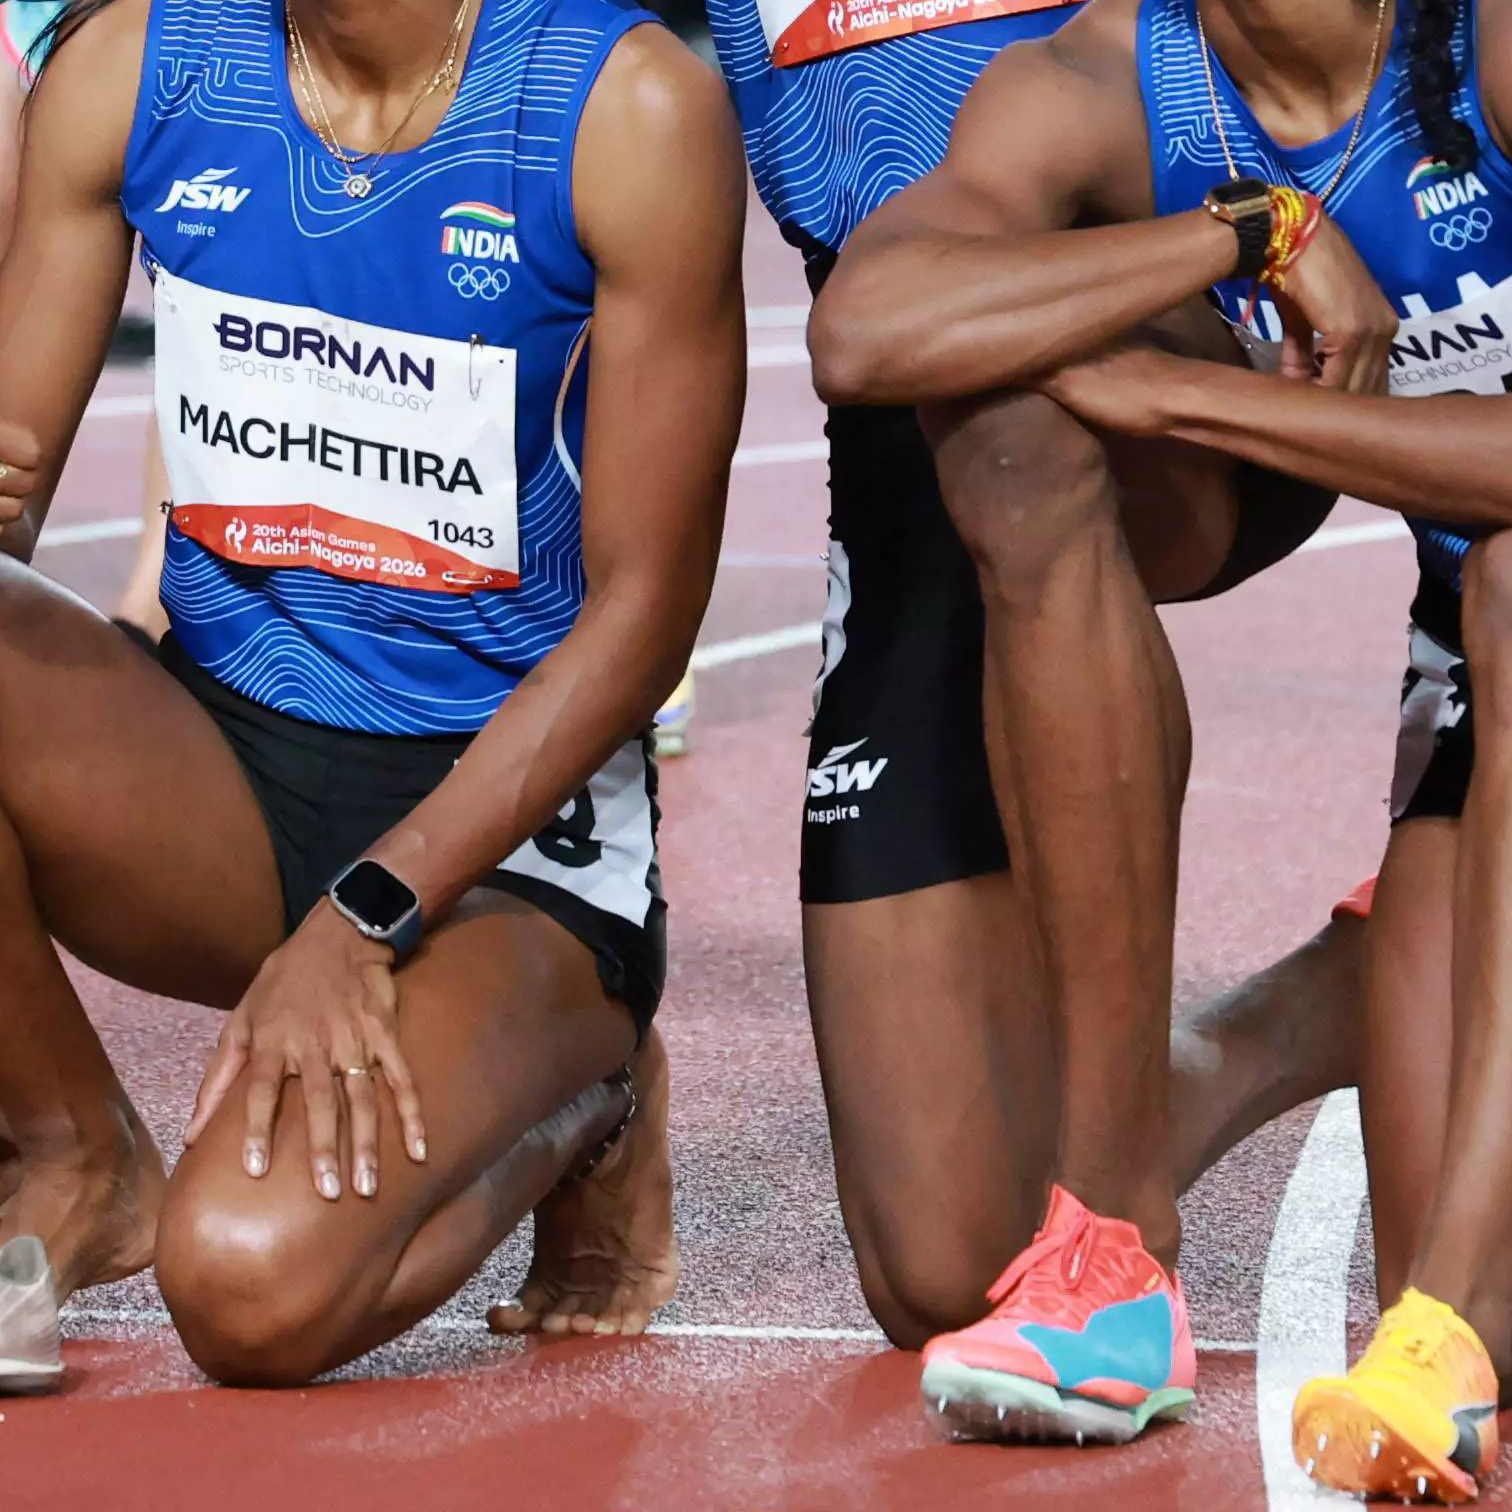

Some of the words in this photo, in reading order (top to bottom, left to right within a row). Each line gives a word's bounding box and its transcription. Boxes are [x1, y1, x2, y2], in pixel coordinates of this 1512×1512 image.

[155, 175, 251, 213] JSW
[1412, 171, 1490, 221] INDIA
[177, 219, 216, 238] Inspire
[441, 226, 520, 264] INDIA
[212, 313, 435, 392] BORNAN
[1389, 313, 1505, 369] NAN
[218, 353, 295, 384] SPORTS
[303, 367, 434, 414] TECHNOLOGY
[179, 394, 484, 496] MACHETTIRA
[252, 523, 286, 538] 20th
[290, 524, 326, 542] Asian
[328, 534, 376, 552] Games
[428, 519, 494, 549] 1043
[251, 539, 376, 572] Aichi-Nagoya
[380, 556, 426, 578] 2026
[807, 804, 860, 825] Inspire
